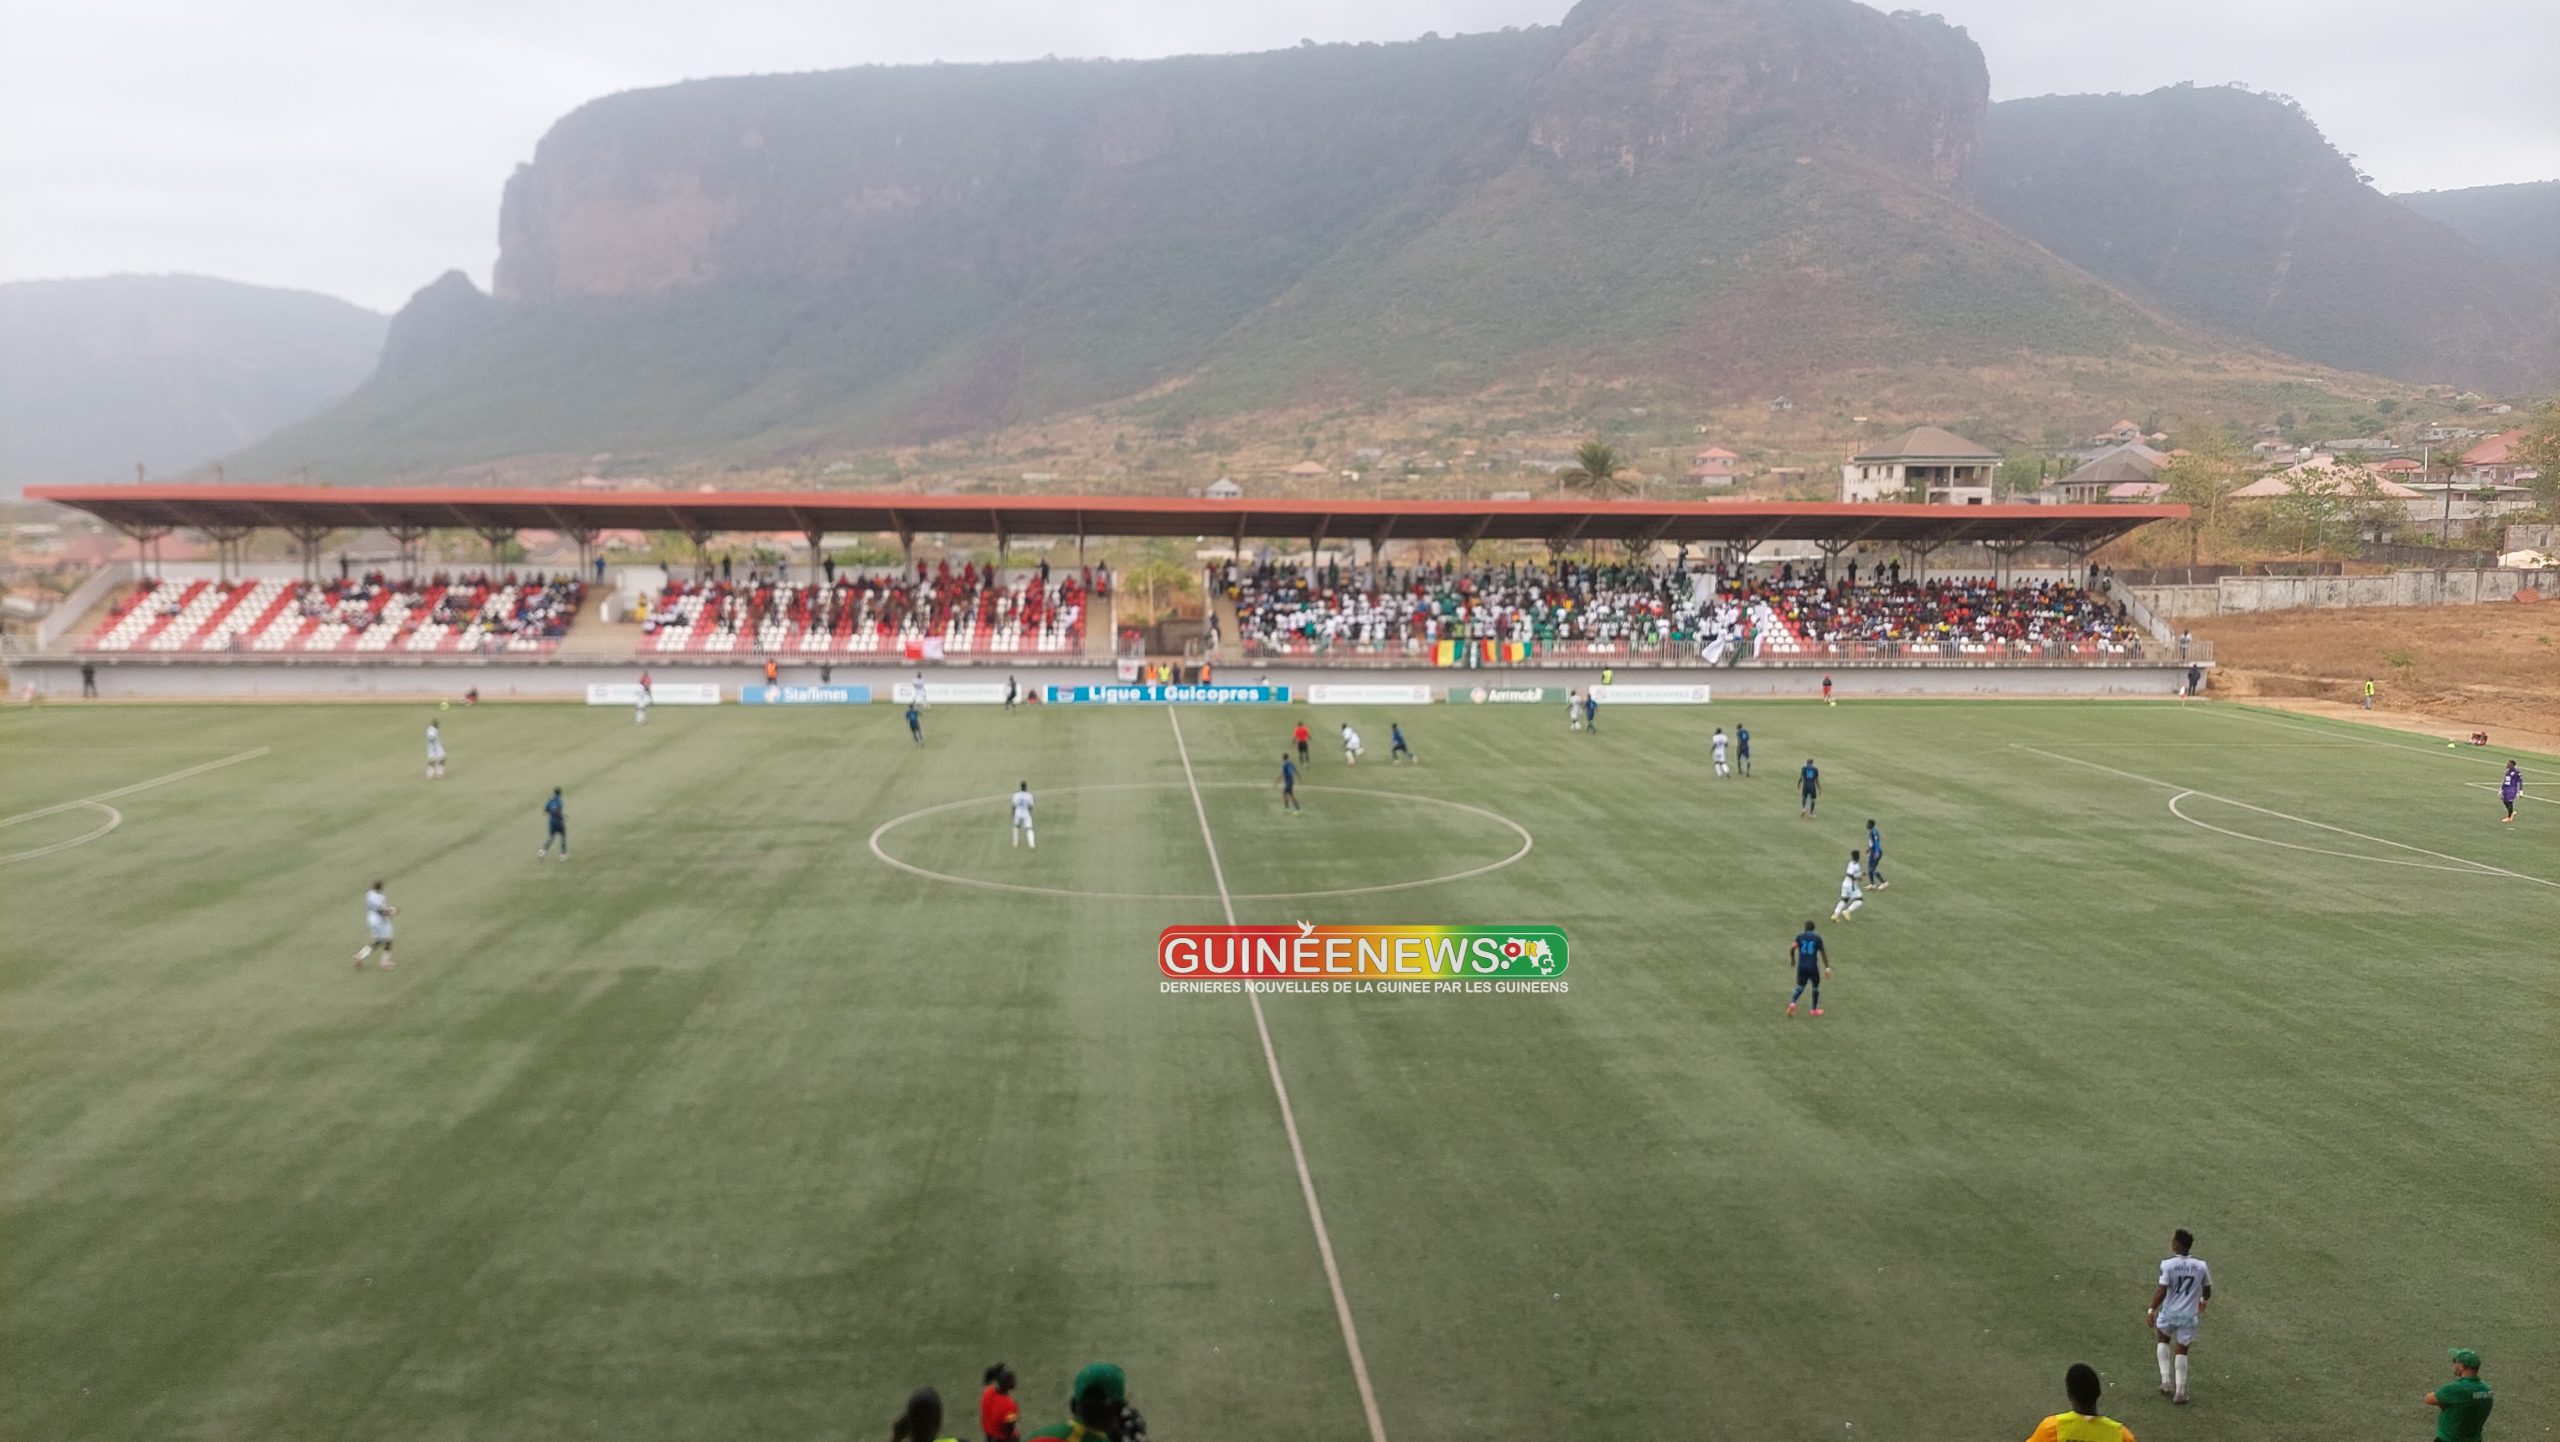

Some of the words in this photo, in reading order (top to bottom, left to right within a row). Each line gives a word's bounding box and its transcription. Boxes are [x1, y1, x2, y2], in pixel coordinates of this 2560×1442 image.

[1088, 686, 1141, 704] Ligue
[1148, 687, 1156, 700] 1
[1164, 687, 1259, 703] Guicopres
[2176, 1276, 2195, 1296] 17
